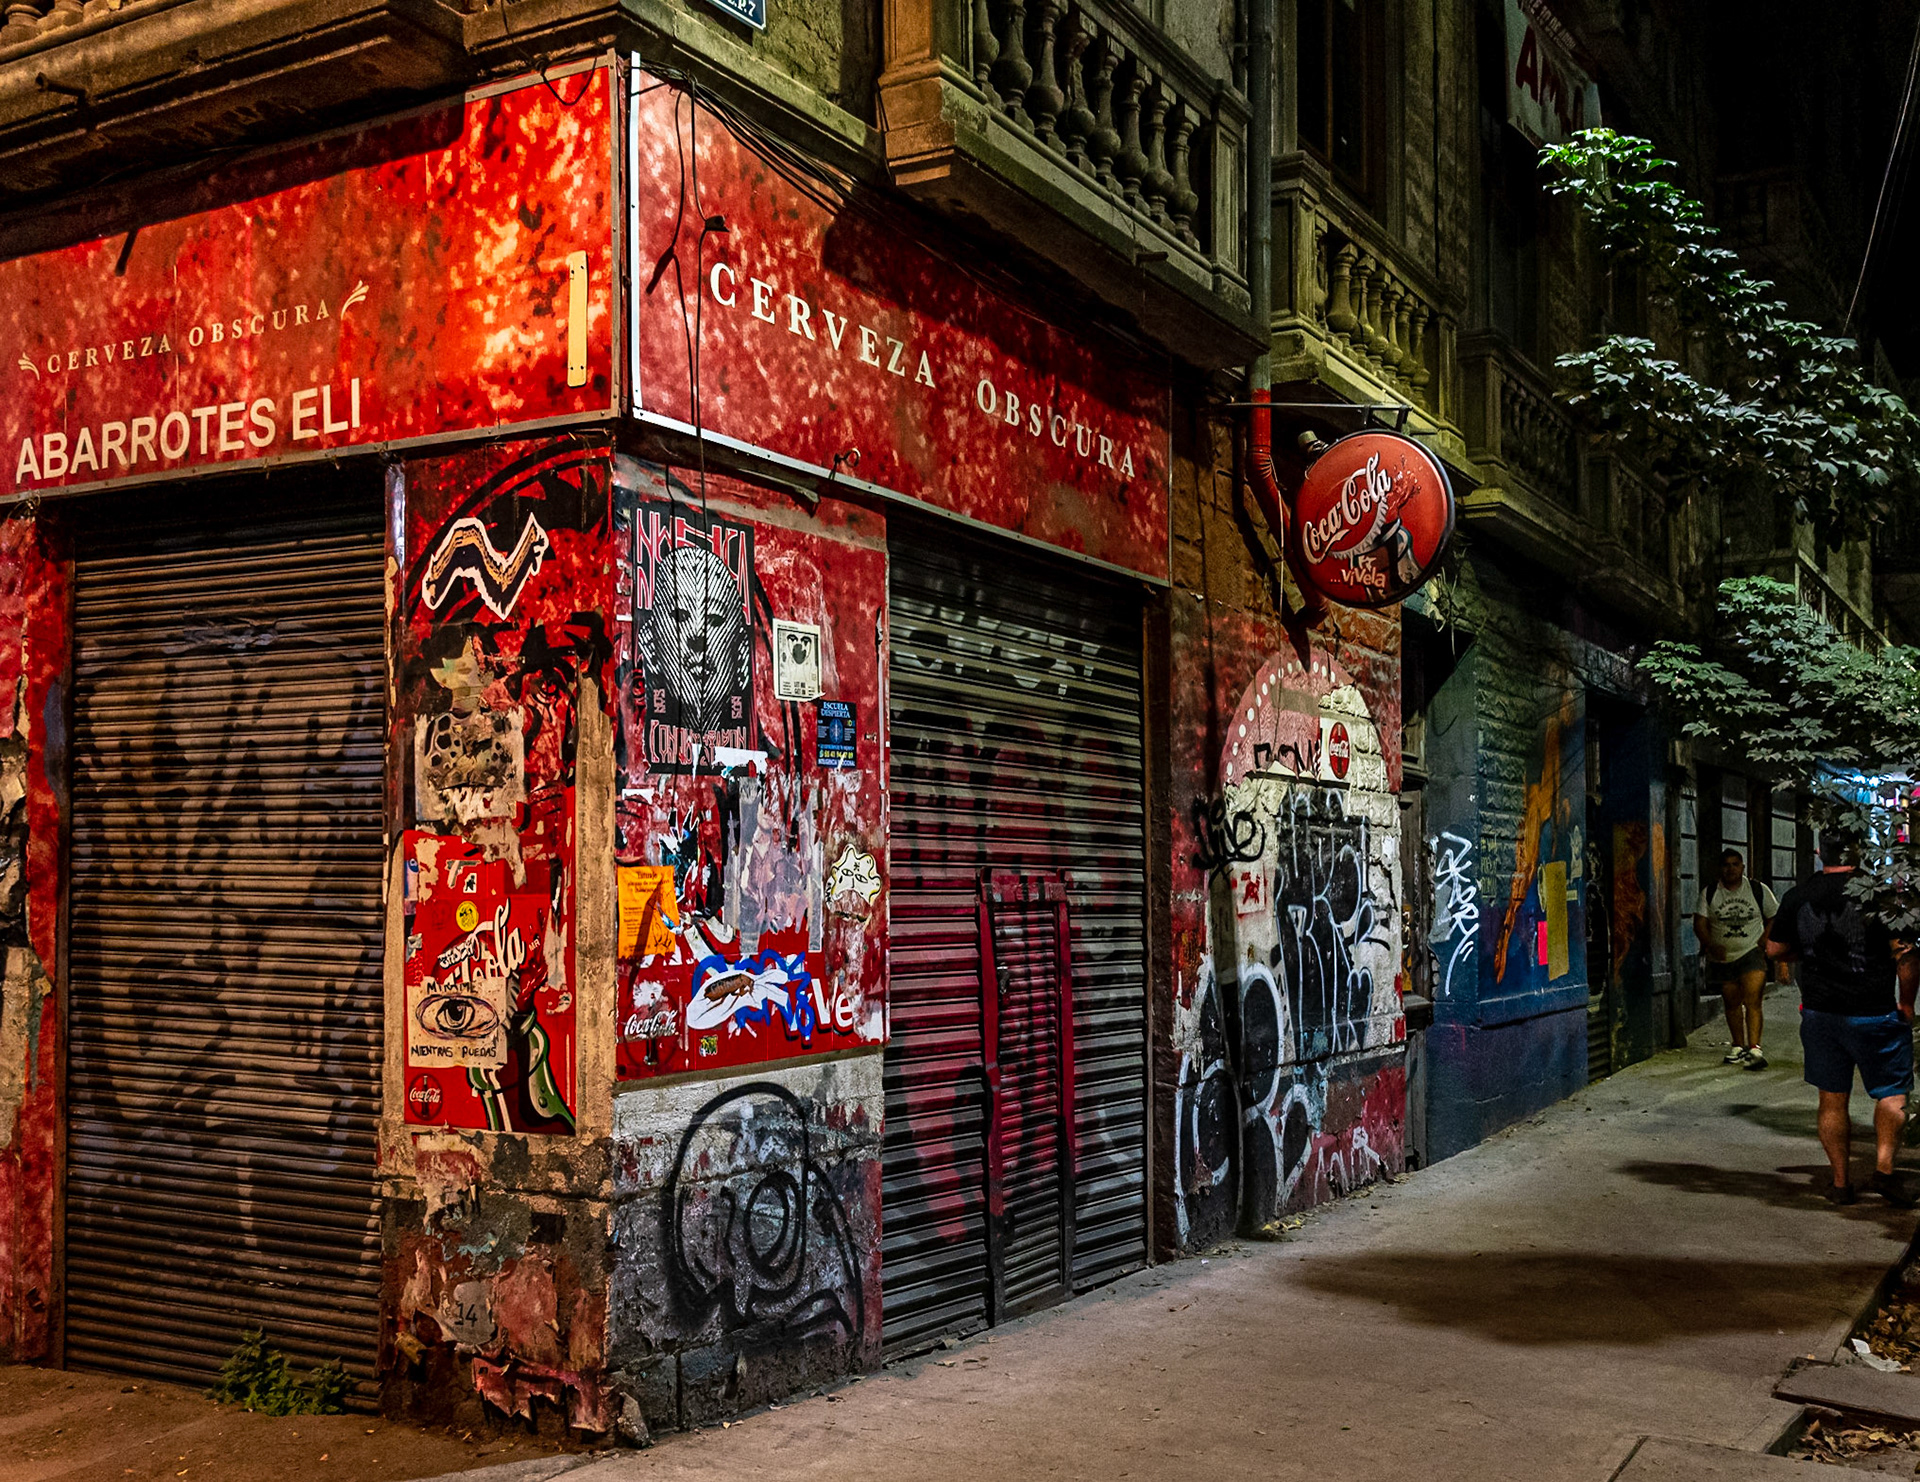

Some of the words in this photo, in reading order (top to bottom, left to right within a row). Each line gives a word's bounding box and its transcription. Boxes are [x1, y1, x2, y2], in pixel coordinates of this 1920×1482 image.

[47, 331, 172, 375] CERVEZA
[188, 298, 330, 348] OBSCURA
[709, 262, 935, 389] CERVEZA
[975, 378, 1135, 479] OBSCURA
[15, 396, 277, 484] ABARROTES
[291, 377, 361, 442] ELI
[1302, 451, 1392, 564] Coca-Cola
